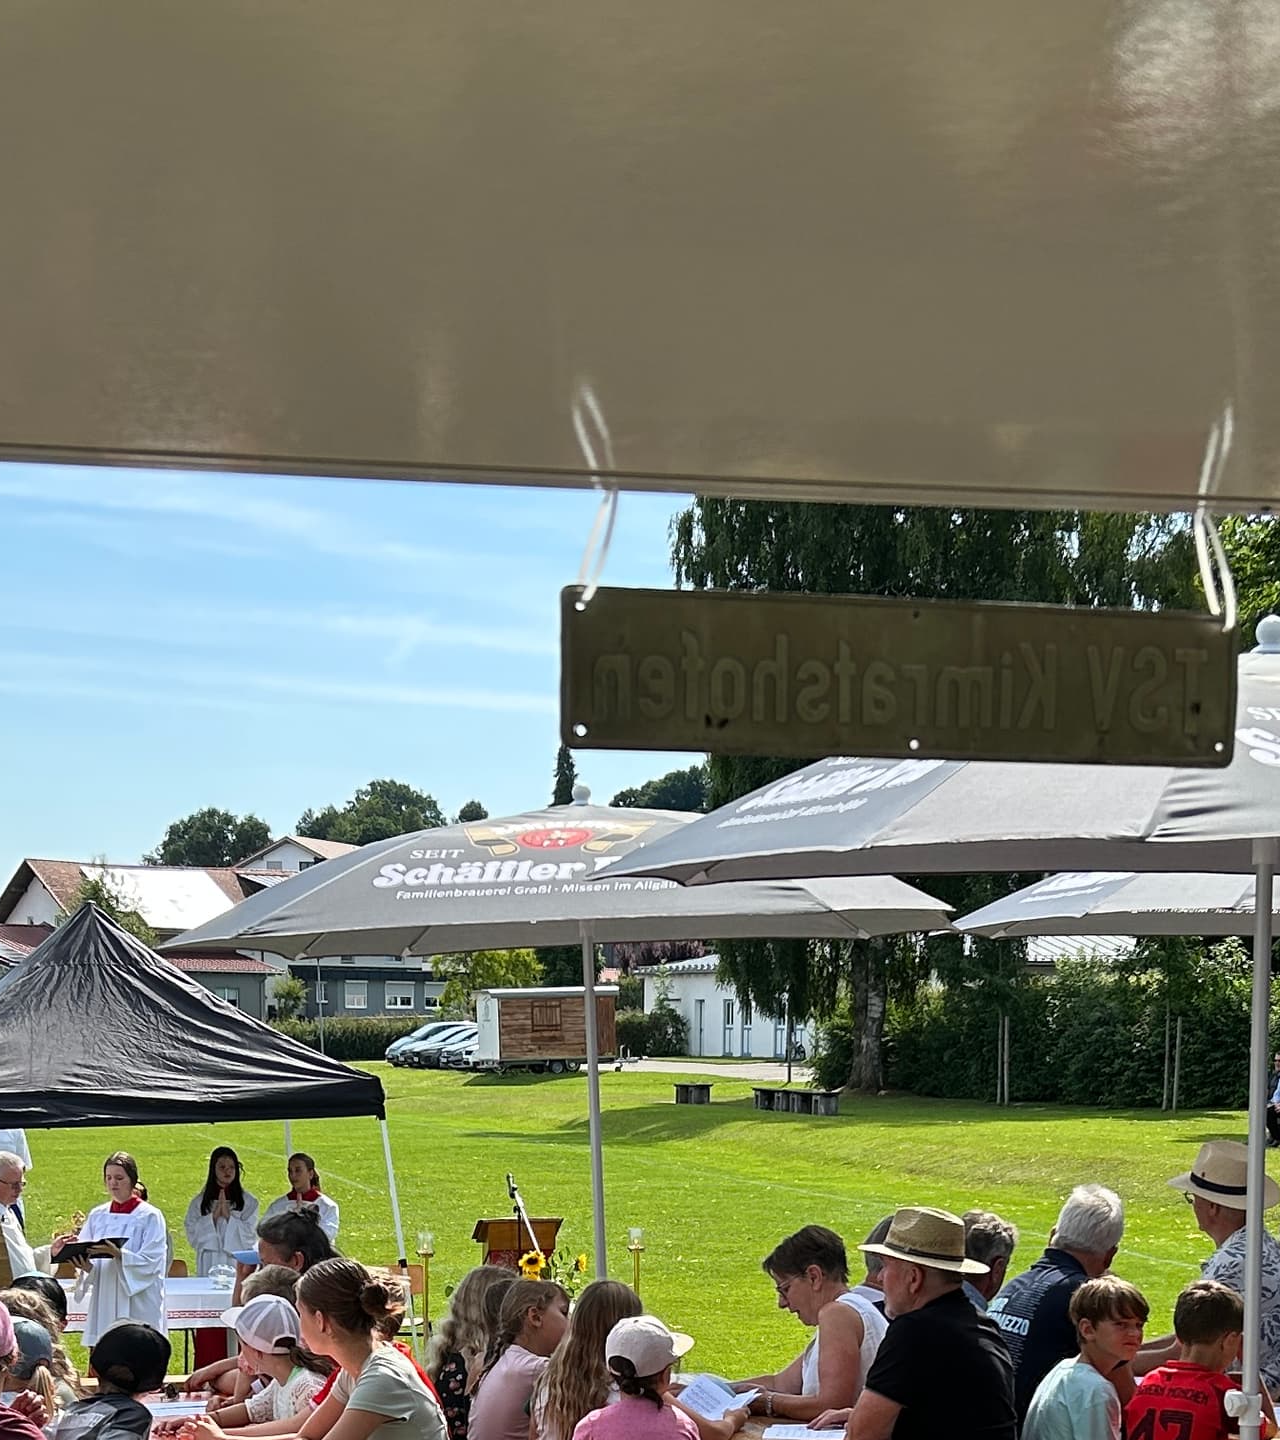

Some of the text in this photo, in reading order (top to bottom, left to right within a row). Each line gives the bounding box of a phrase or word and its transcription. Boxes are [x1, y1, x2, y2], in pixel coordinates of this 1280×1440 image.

[410, 849, 464, 859] SEIT
[372, 859, 586, 888] Schäffler
[396, 888, 511, 900] Familienbrauerei
[561, 883, 610, 894] Missen
[613, 881, 631, 891] im
[634, 879, 678, 892] Allgäu
